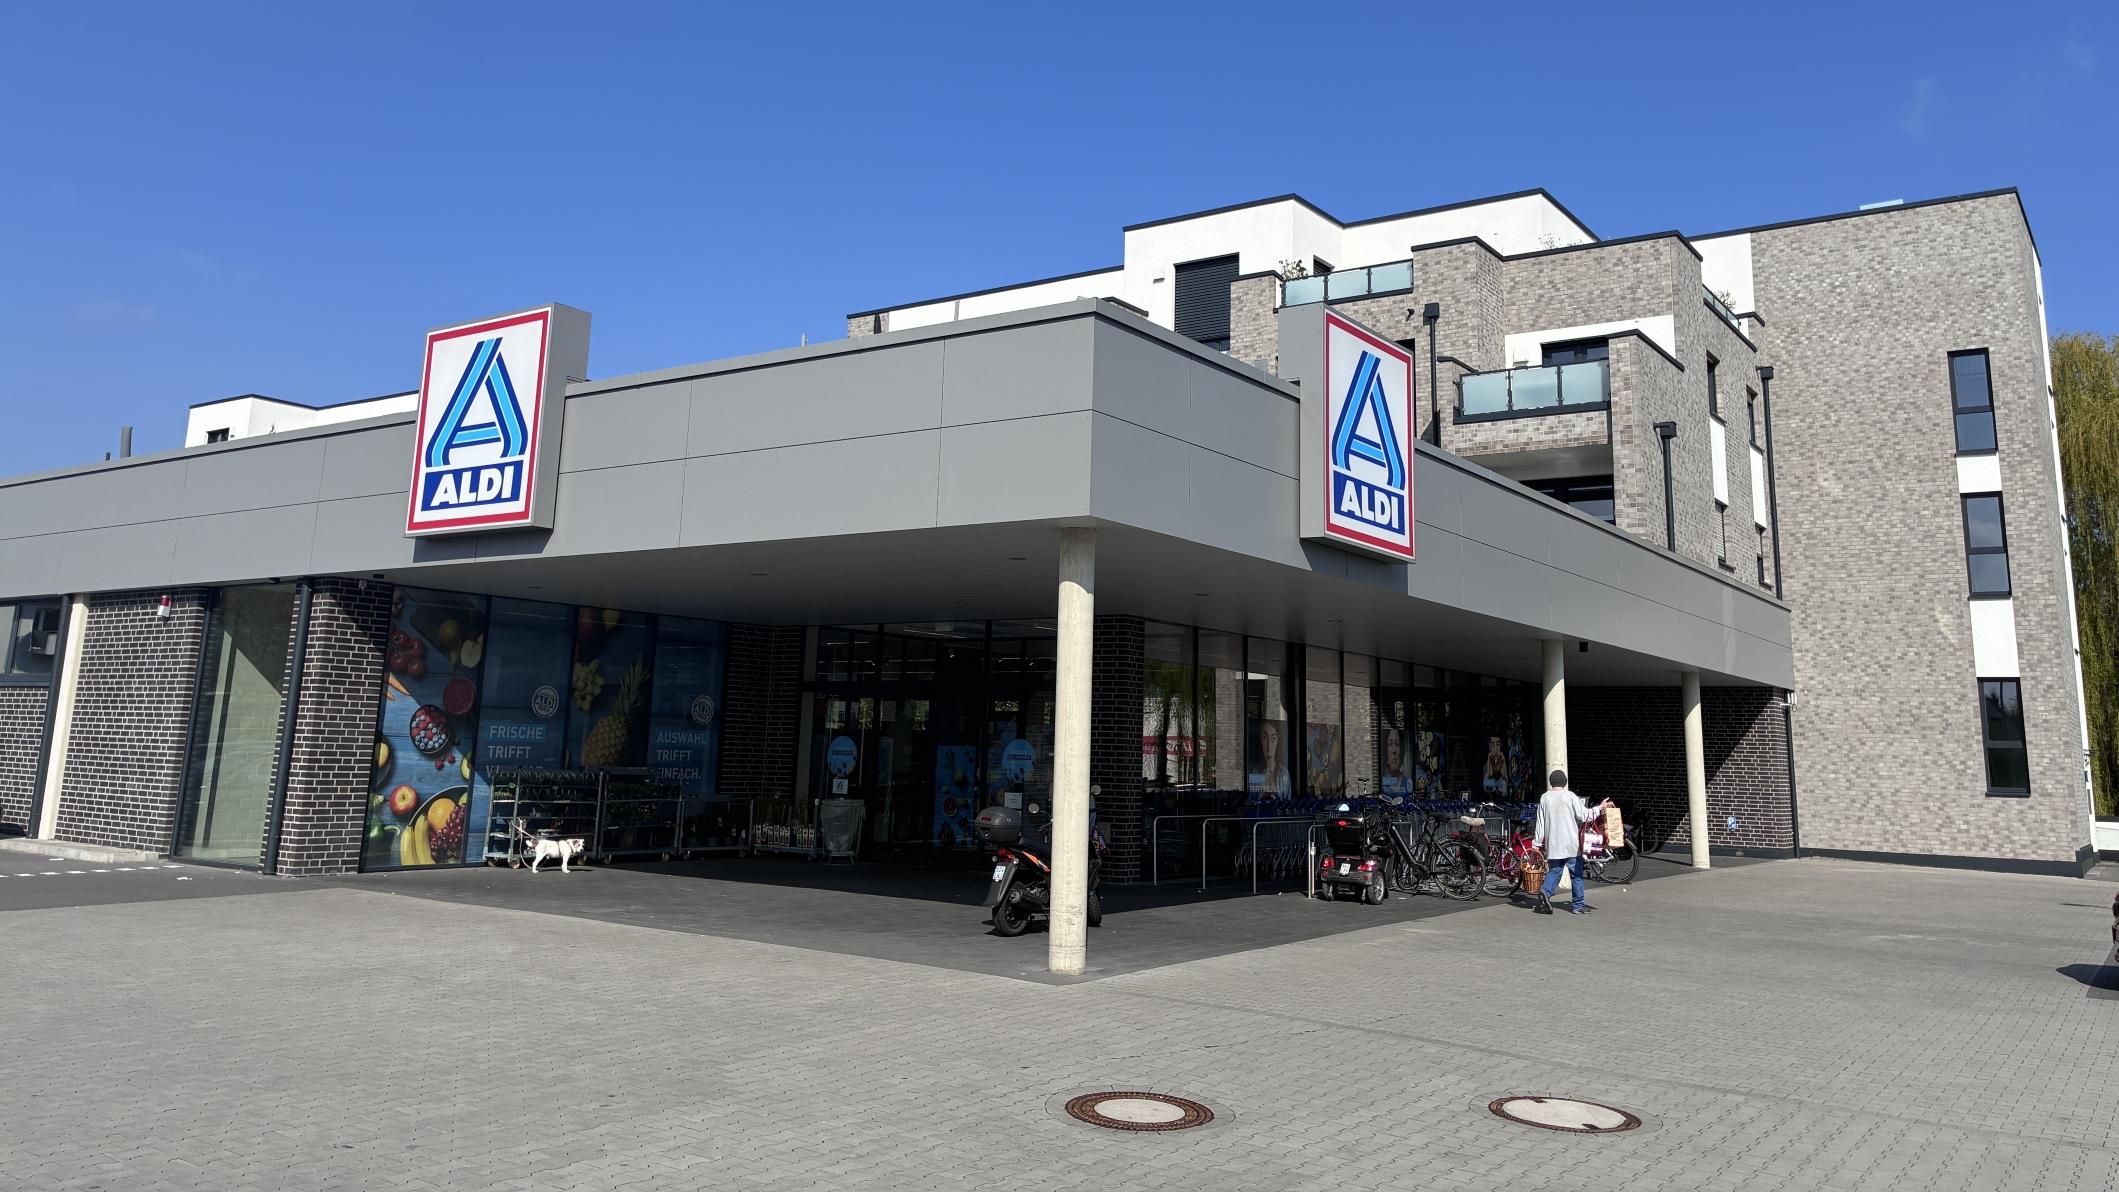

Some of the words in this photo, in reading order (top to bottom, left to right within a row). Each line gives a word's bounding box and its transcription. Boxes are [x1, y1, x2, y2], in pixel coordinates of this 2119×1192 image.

[430, 466, 514, 507] ALDI
[1340, 479, 1399, 529] ALDI
[489, 725, 543, 739] FRISCHE
[656, 731, 707, 744] AUSWAHL
[488, 745, 531, 759] TRIFFT
[656, 749, 693, 762] TRIFFT
